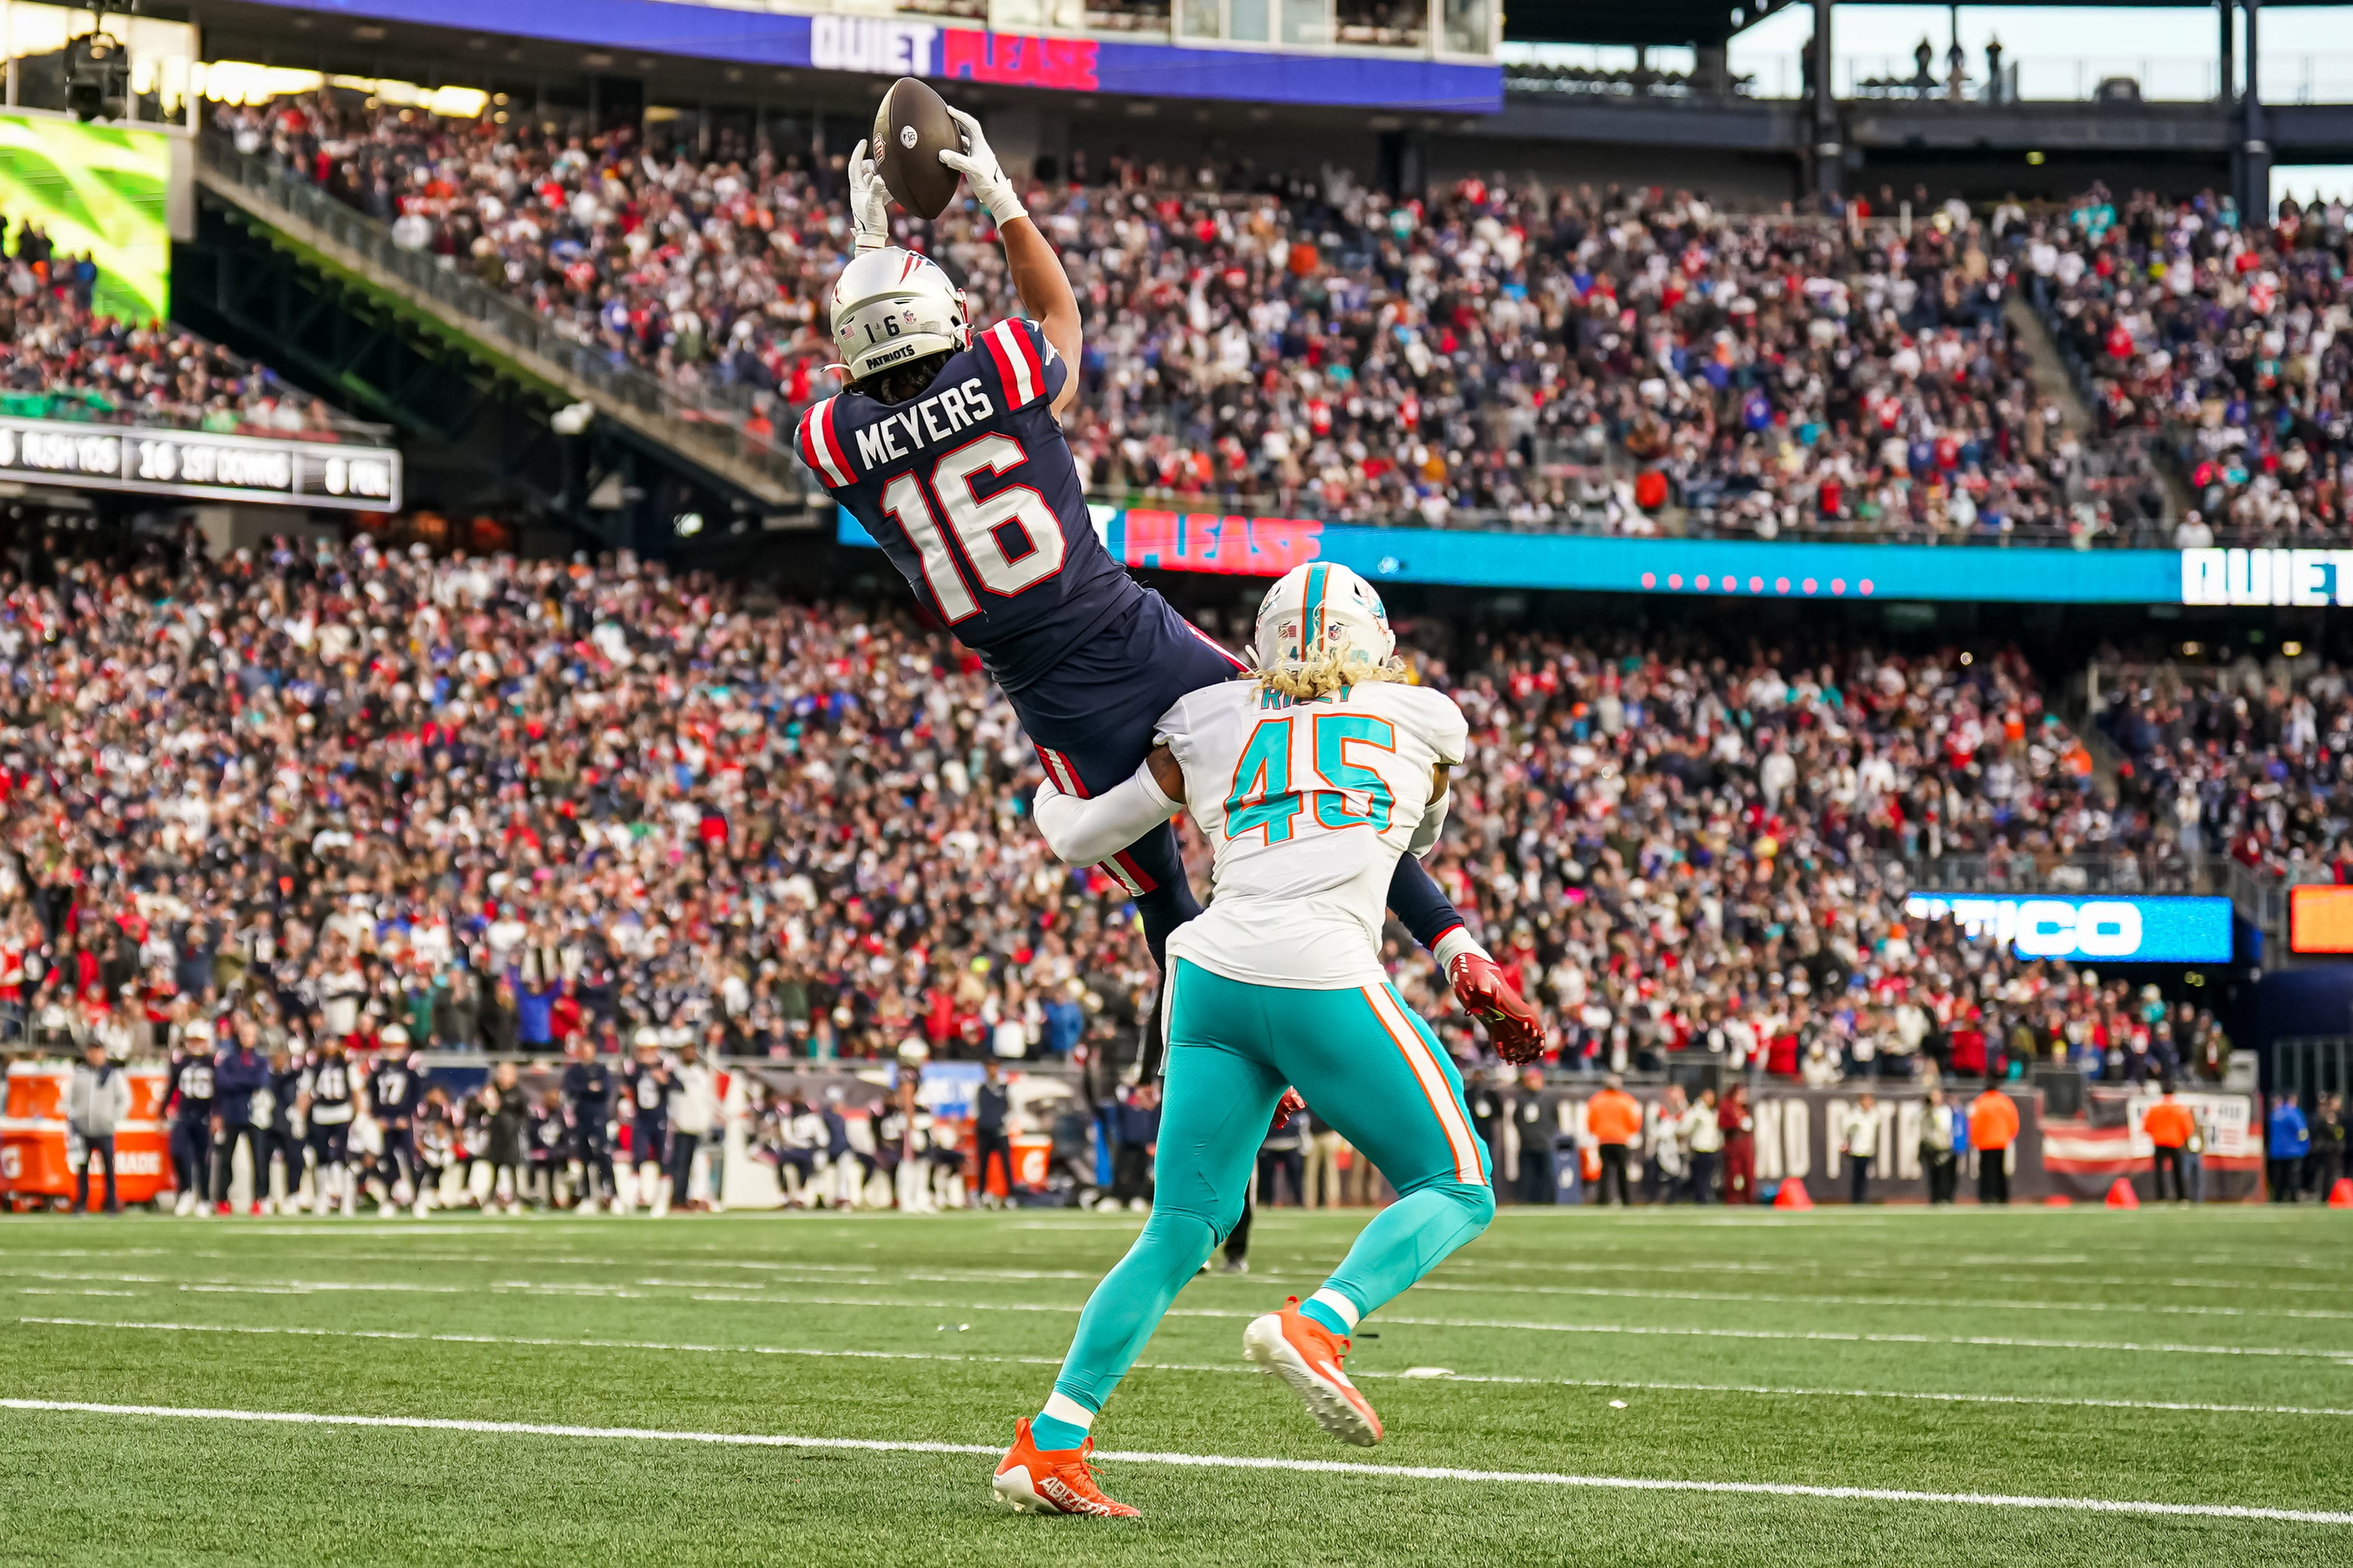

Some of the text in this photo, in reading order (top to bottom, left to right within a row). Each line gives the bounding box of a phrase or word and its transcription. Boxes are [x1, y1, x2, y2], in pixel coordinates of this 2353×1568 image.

[811, 14, 1099, 92] QUIET PLEASE
[865, 344, 916, 370] PATRIOTS
[855, 377, 994, 470] MEYERS
[880, 431, 1067, 627] 16
[1125, 509, 1325, 577] PLEASE
[1223, 712, 1396, 847] 45
[377, 1071, 408, 1106] 17
